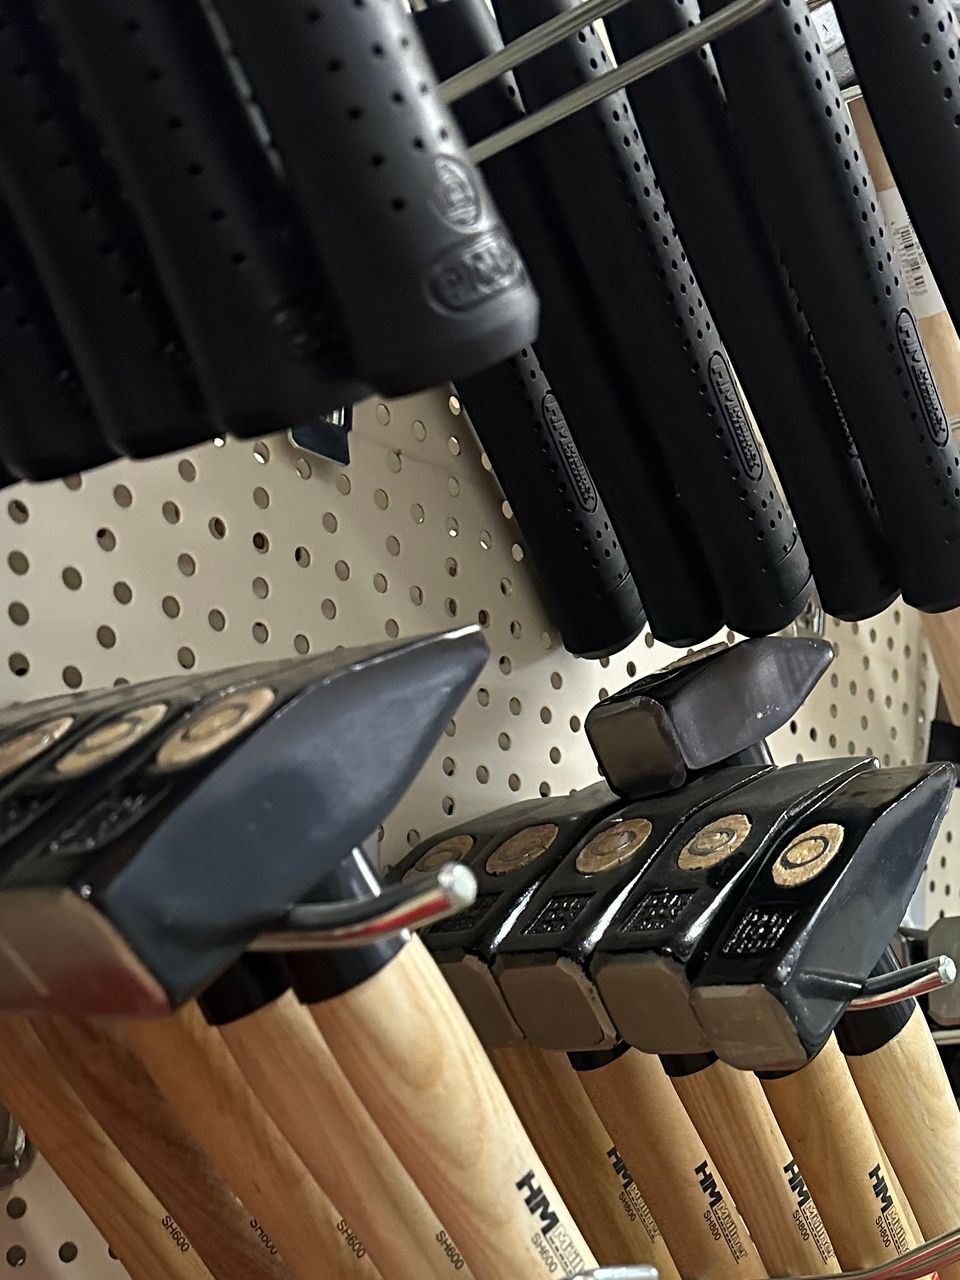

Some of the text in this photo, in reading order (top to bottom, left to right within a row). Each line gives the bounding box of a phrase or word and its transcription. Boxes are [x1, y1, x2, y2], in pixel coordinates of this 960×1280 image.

[607, 1146, 633, 1191] HM
[783, 1159, 811, 1207] HM
[868, 1163, 894, 1214] HM
[515, 1169, 560, 1236] HM
[617, 1191, 637, 1223] SH800
[694, 1160, 748, 1258] HM Müllner
[161, 1214, 190, 1252] SH600
[336, 1218, 366, 1260] SH600
[702, 1211, 723, 1242] SH800
[792, 1209, 811, 1241] SH800
[875, 1215, 892, 1248] SH800
[434, 1229, 465, 1271] SH600
[530, 1232, 558, 1274] SH600
